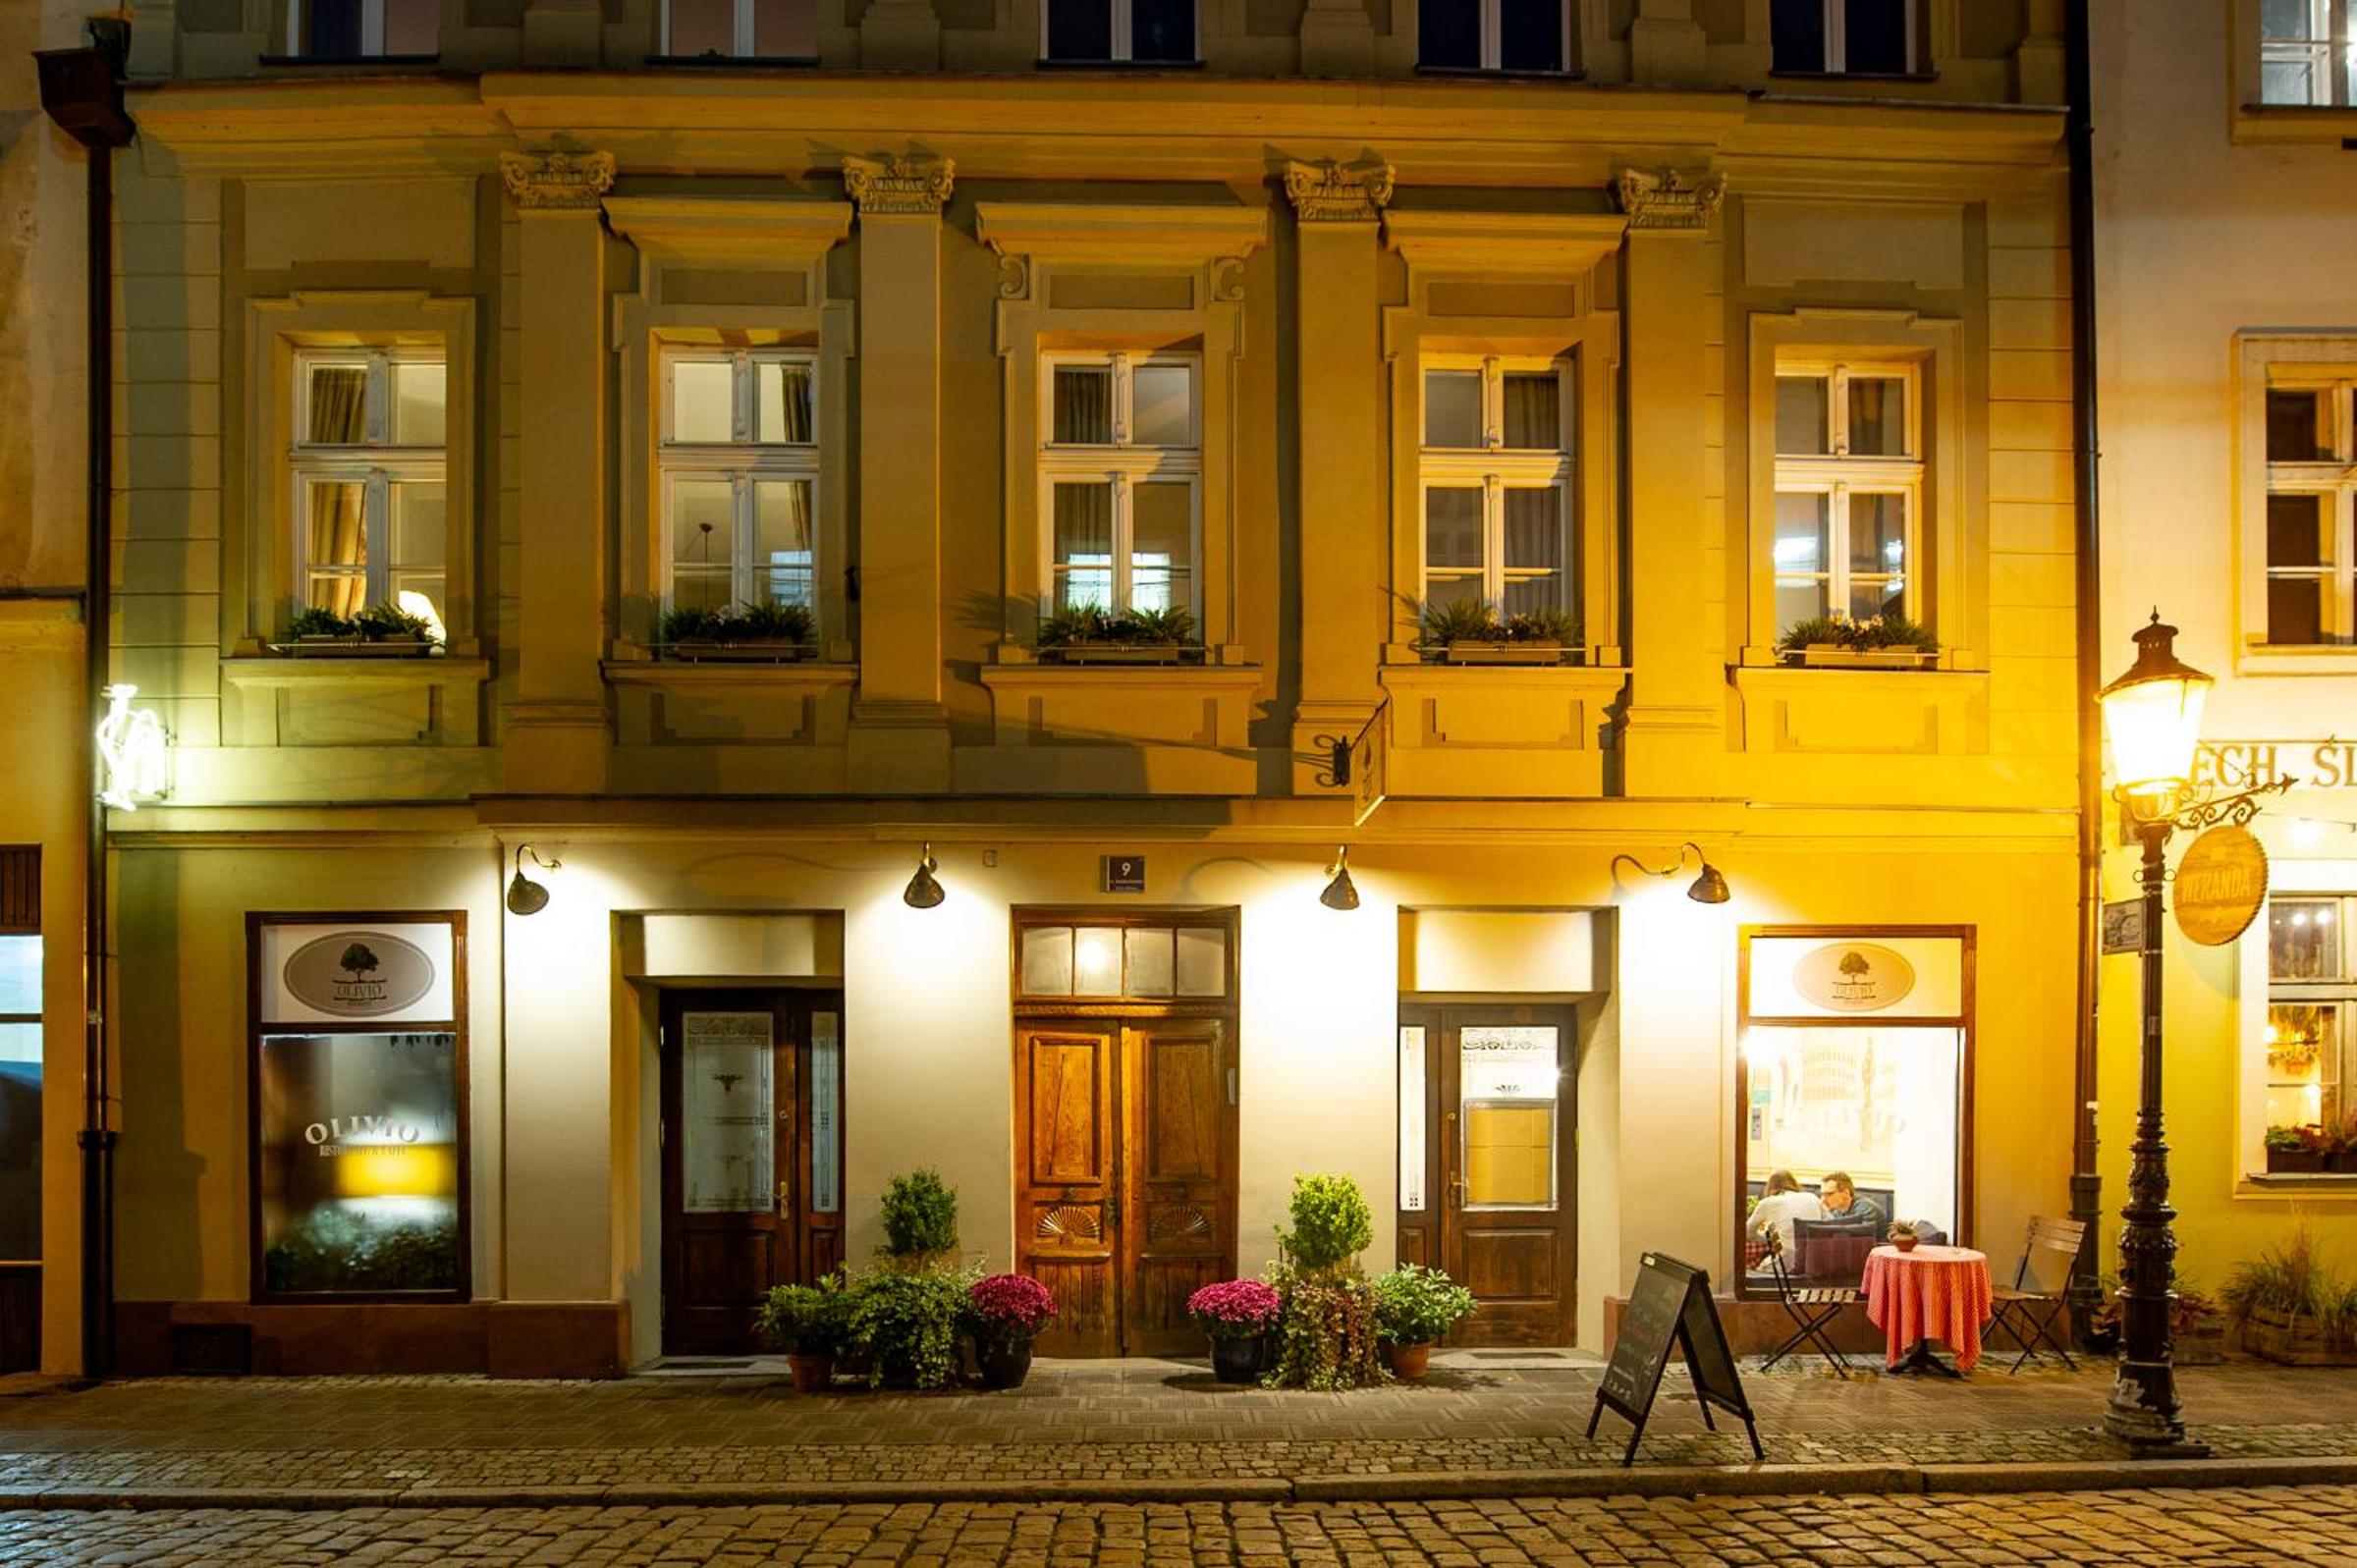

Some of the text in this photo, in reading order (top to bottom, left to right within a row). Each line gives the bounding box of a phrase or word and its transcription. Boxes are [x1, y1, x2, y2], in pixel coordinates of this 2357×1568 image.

[1122, 862, 1131, 877] 9
[2182, 867, 2251, 902] WERANDA
[337, 984, 382, 998] OLIVIO
[305, 1115, 419, 1145] OLIVIO
